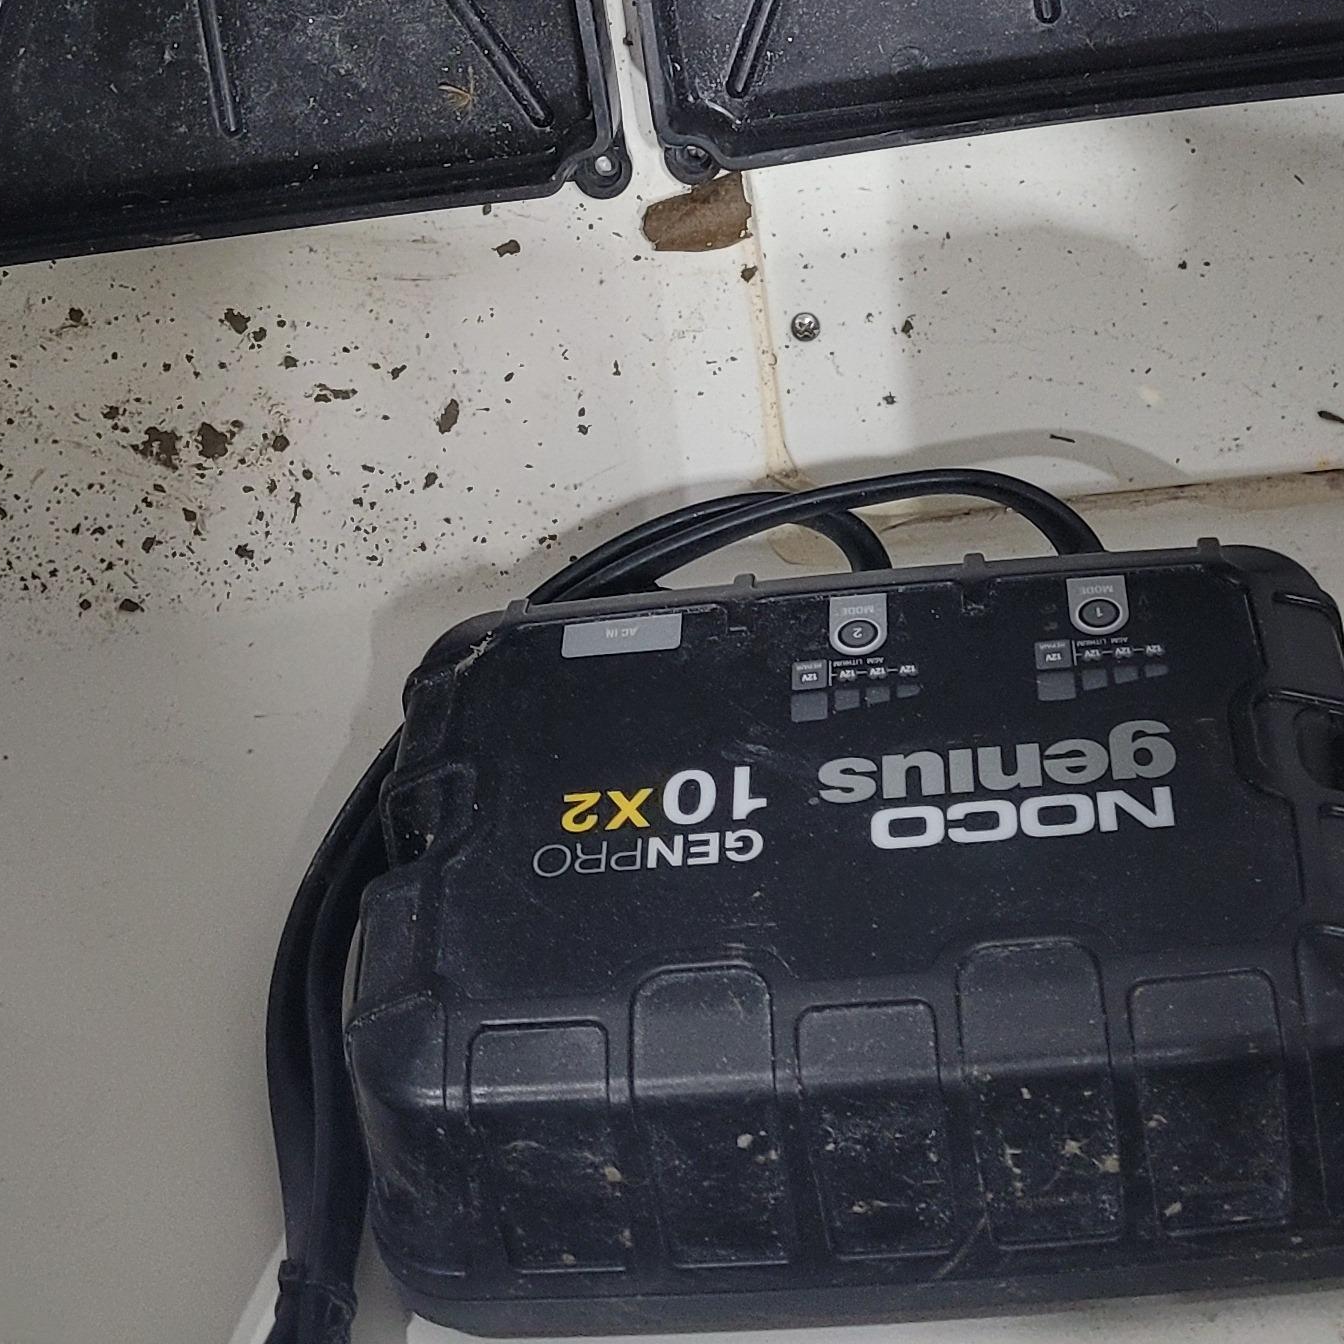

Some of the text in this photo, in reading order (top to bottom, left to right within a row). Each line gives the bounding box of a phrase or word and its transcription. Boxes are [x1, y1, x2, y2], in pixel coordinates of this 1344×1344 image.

[1080, 584, 1114, 595] MODE
[840, 604, 875, 616] MODE
[1096, 607, 1104, 617] 1
[606, 627, 638, 639] AC IN
[853, 627, 863, 638] 2
[1045, 652, 1063, 663] 12V
[801, 672, 818, 683] 12V
[838, 669, 856, 679] 12V
[868, 667, 887, 677] 12V
[817, 719, 1176, 805] genius
[870, 786, 1175, 850] NOCO
[531, 830, 766, 878] GENPRO
